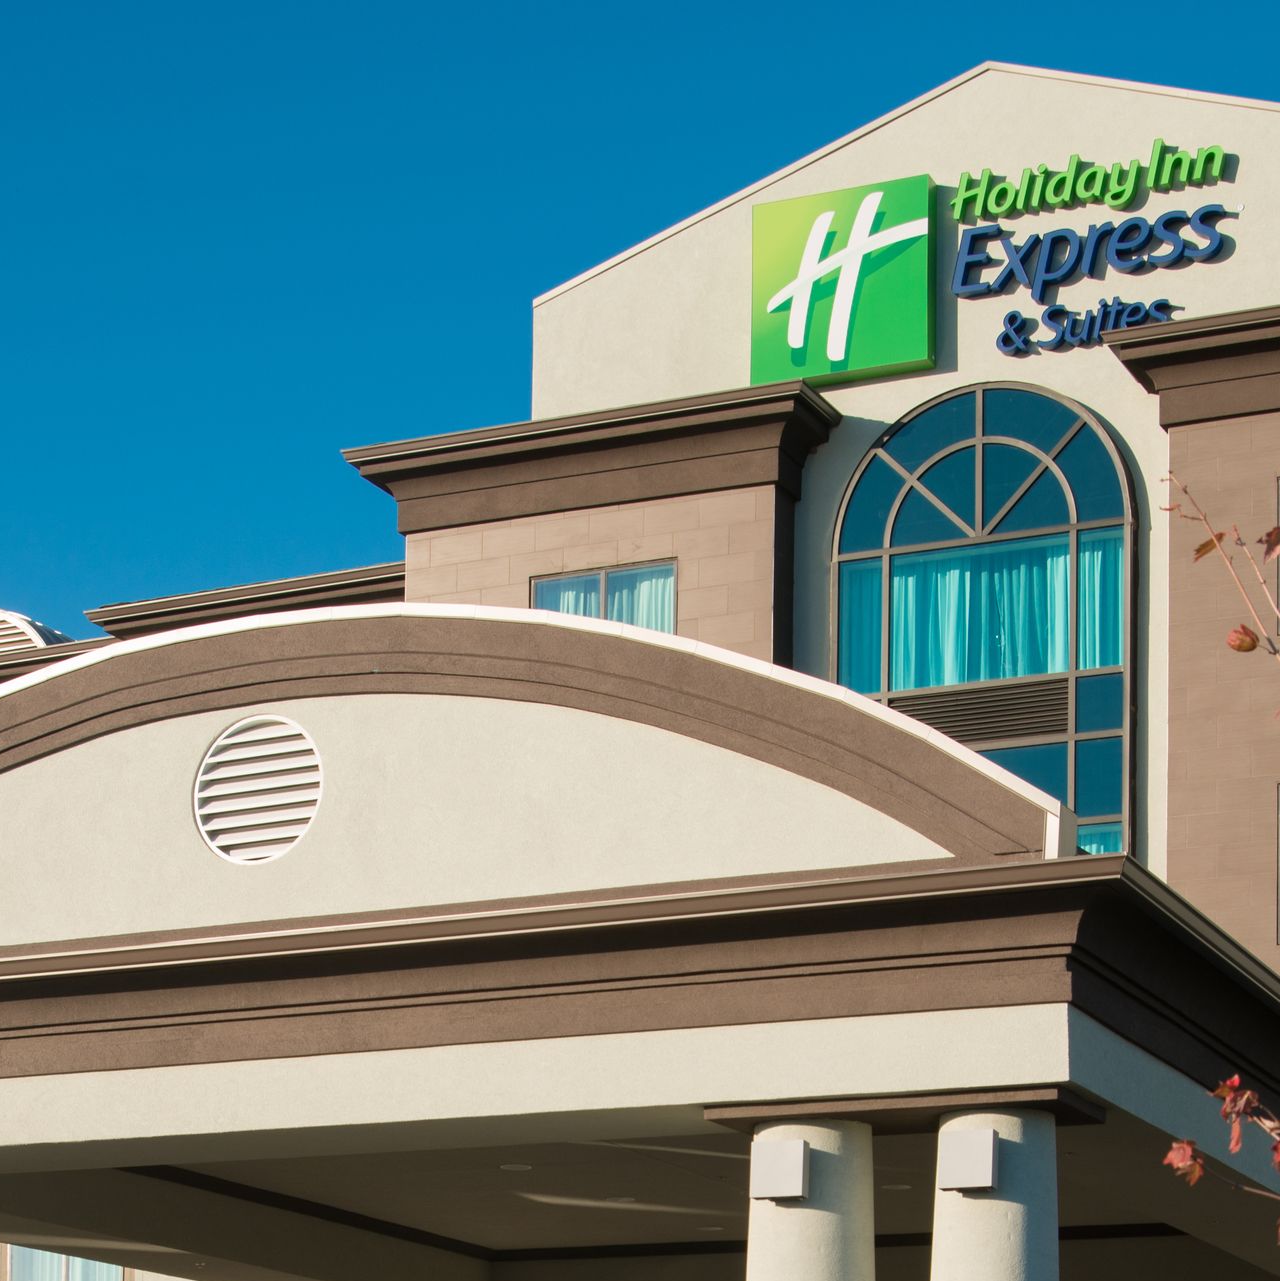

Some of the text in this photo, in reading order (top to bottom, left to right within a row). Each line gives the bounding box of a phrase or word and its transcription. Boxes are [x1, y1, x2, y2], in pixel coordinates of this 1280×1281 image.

[950, 139, 1226, 222] Holiday Inn
[950, 203, 1227, 305] Express
[996, 296, 1170, 356] & Suites
